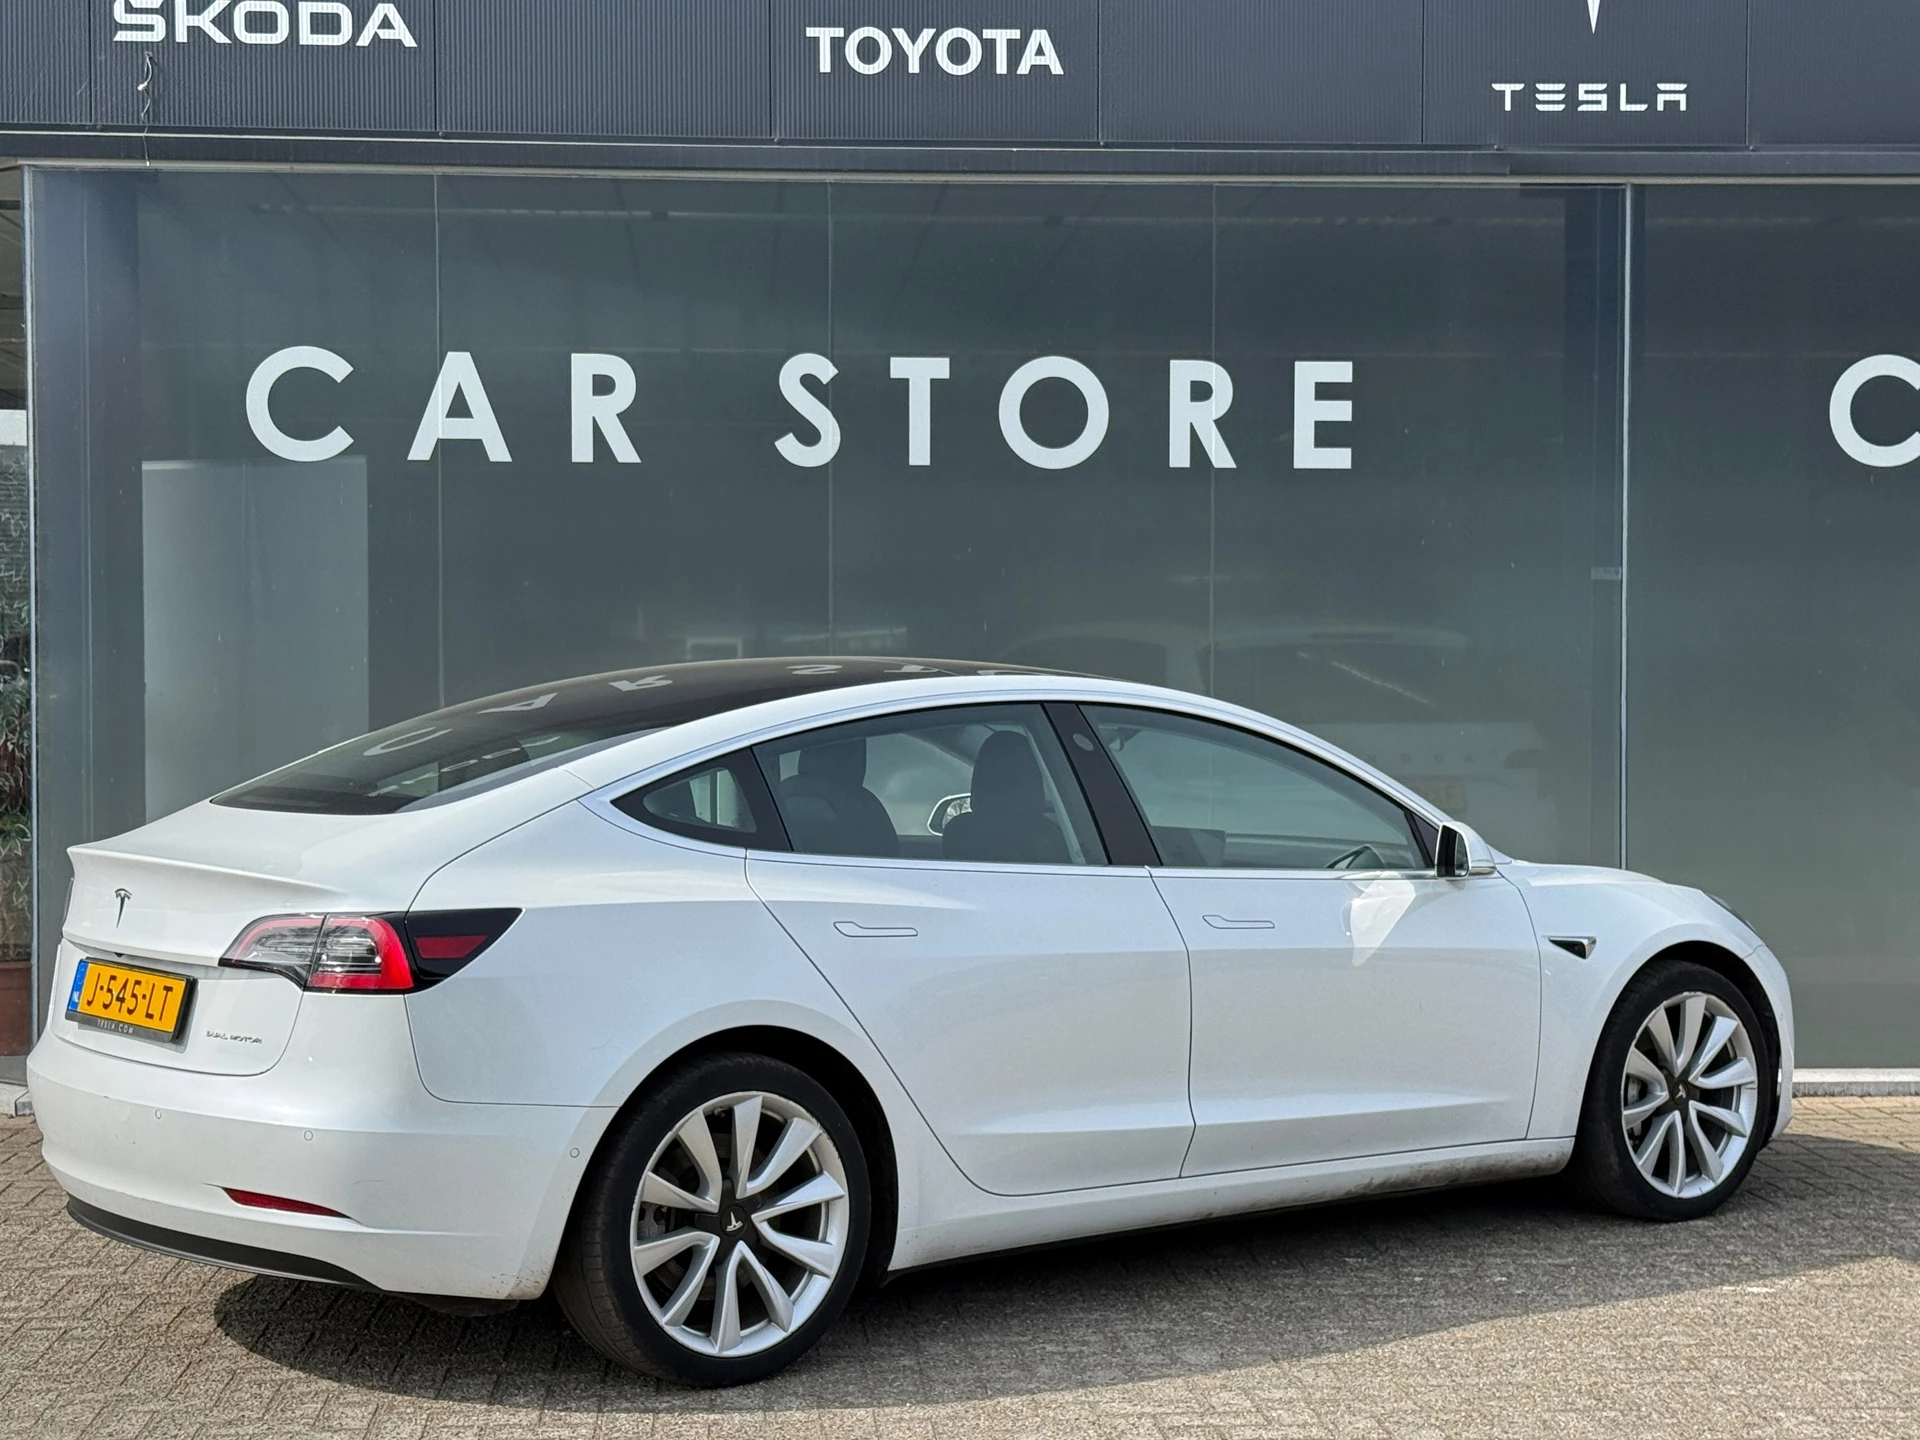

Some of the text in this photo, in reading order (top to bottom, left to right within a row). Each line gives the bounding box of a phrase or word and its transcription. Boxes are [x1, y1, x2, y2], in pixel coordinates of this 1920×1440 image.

[806, 26, 1064, 76] TOYOTA
[1491, 82, 1688, 112] TESLA
[245, 345, 1355, 470] CAR STORE
[1828, 354, 1920, 468] C
[97, 1019, 134, 1034] TESLA.COM
